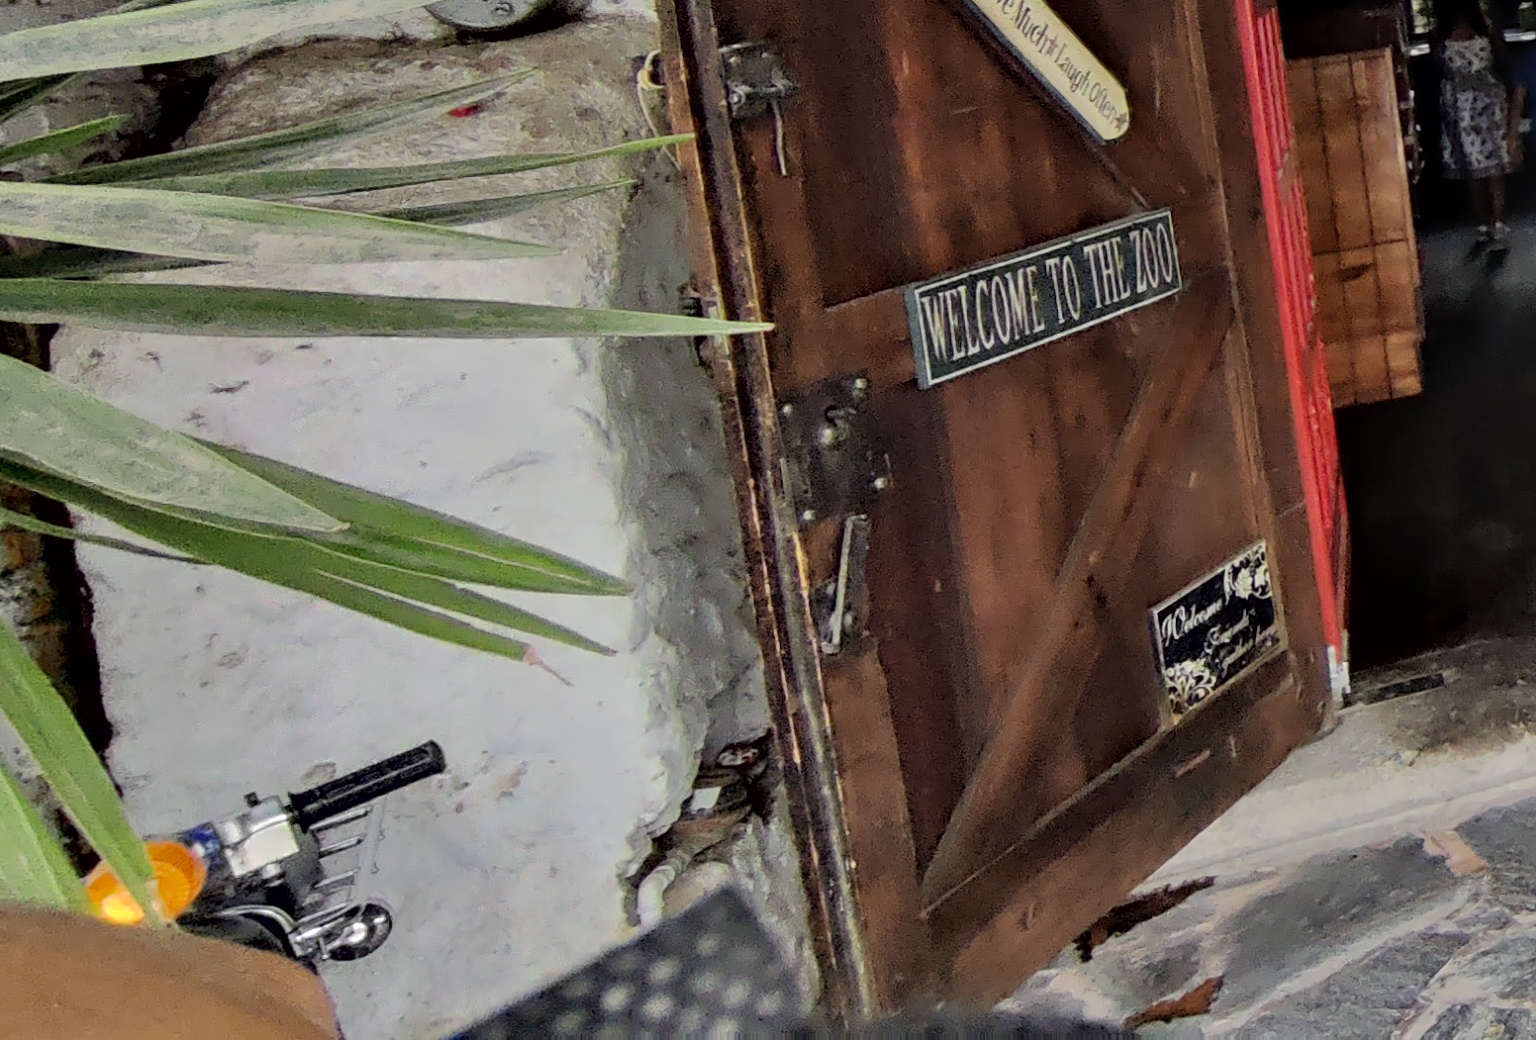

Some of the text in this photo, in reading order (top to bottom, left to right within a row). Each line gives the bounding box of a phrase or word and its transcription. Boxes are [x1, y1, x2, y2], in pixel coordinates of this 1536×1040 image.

[1054, 42, 1090, 94] Laugh
[1089, 82, 1117, 125] Often
[921, 222, 1173, 361] WELCOME TO THE ZOO
